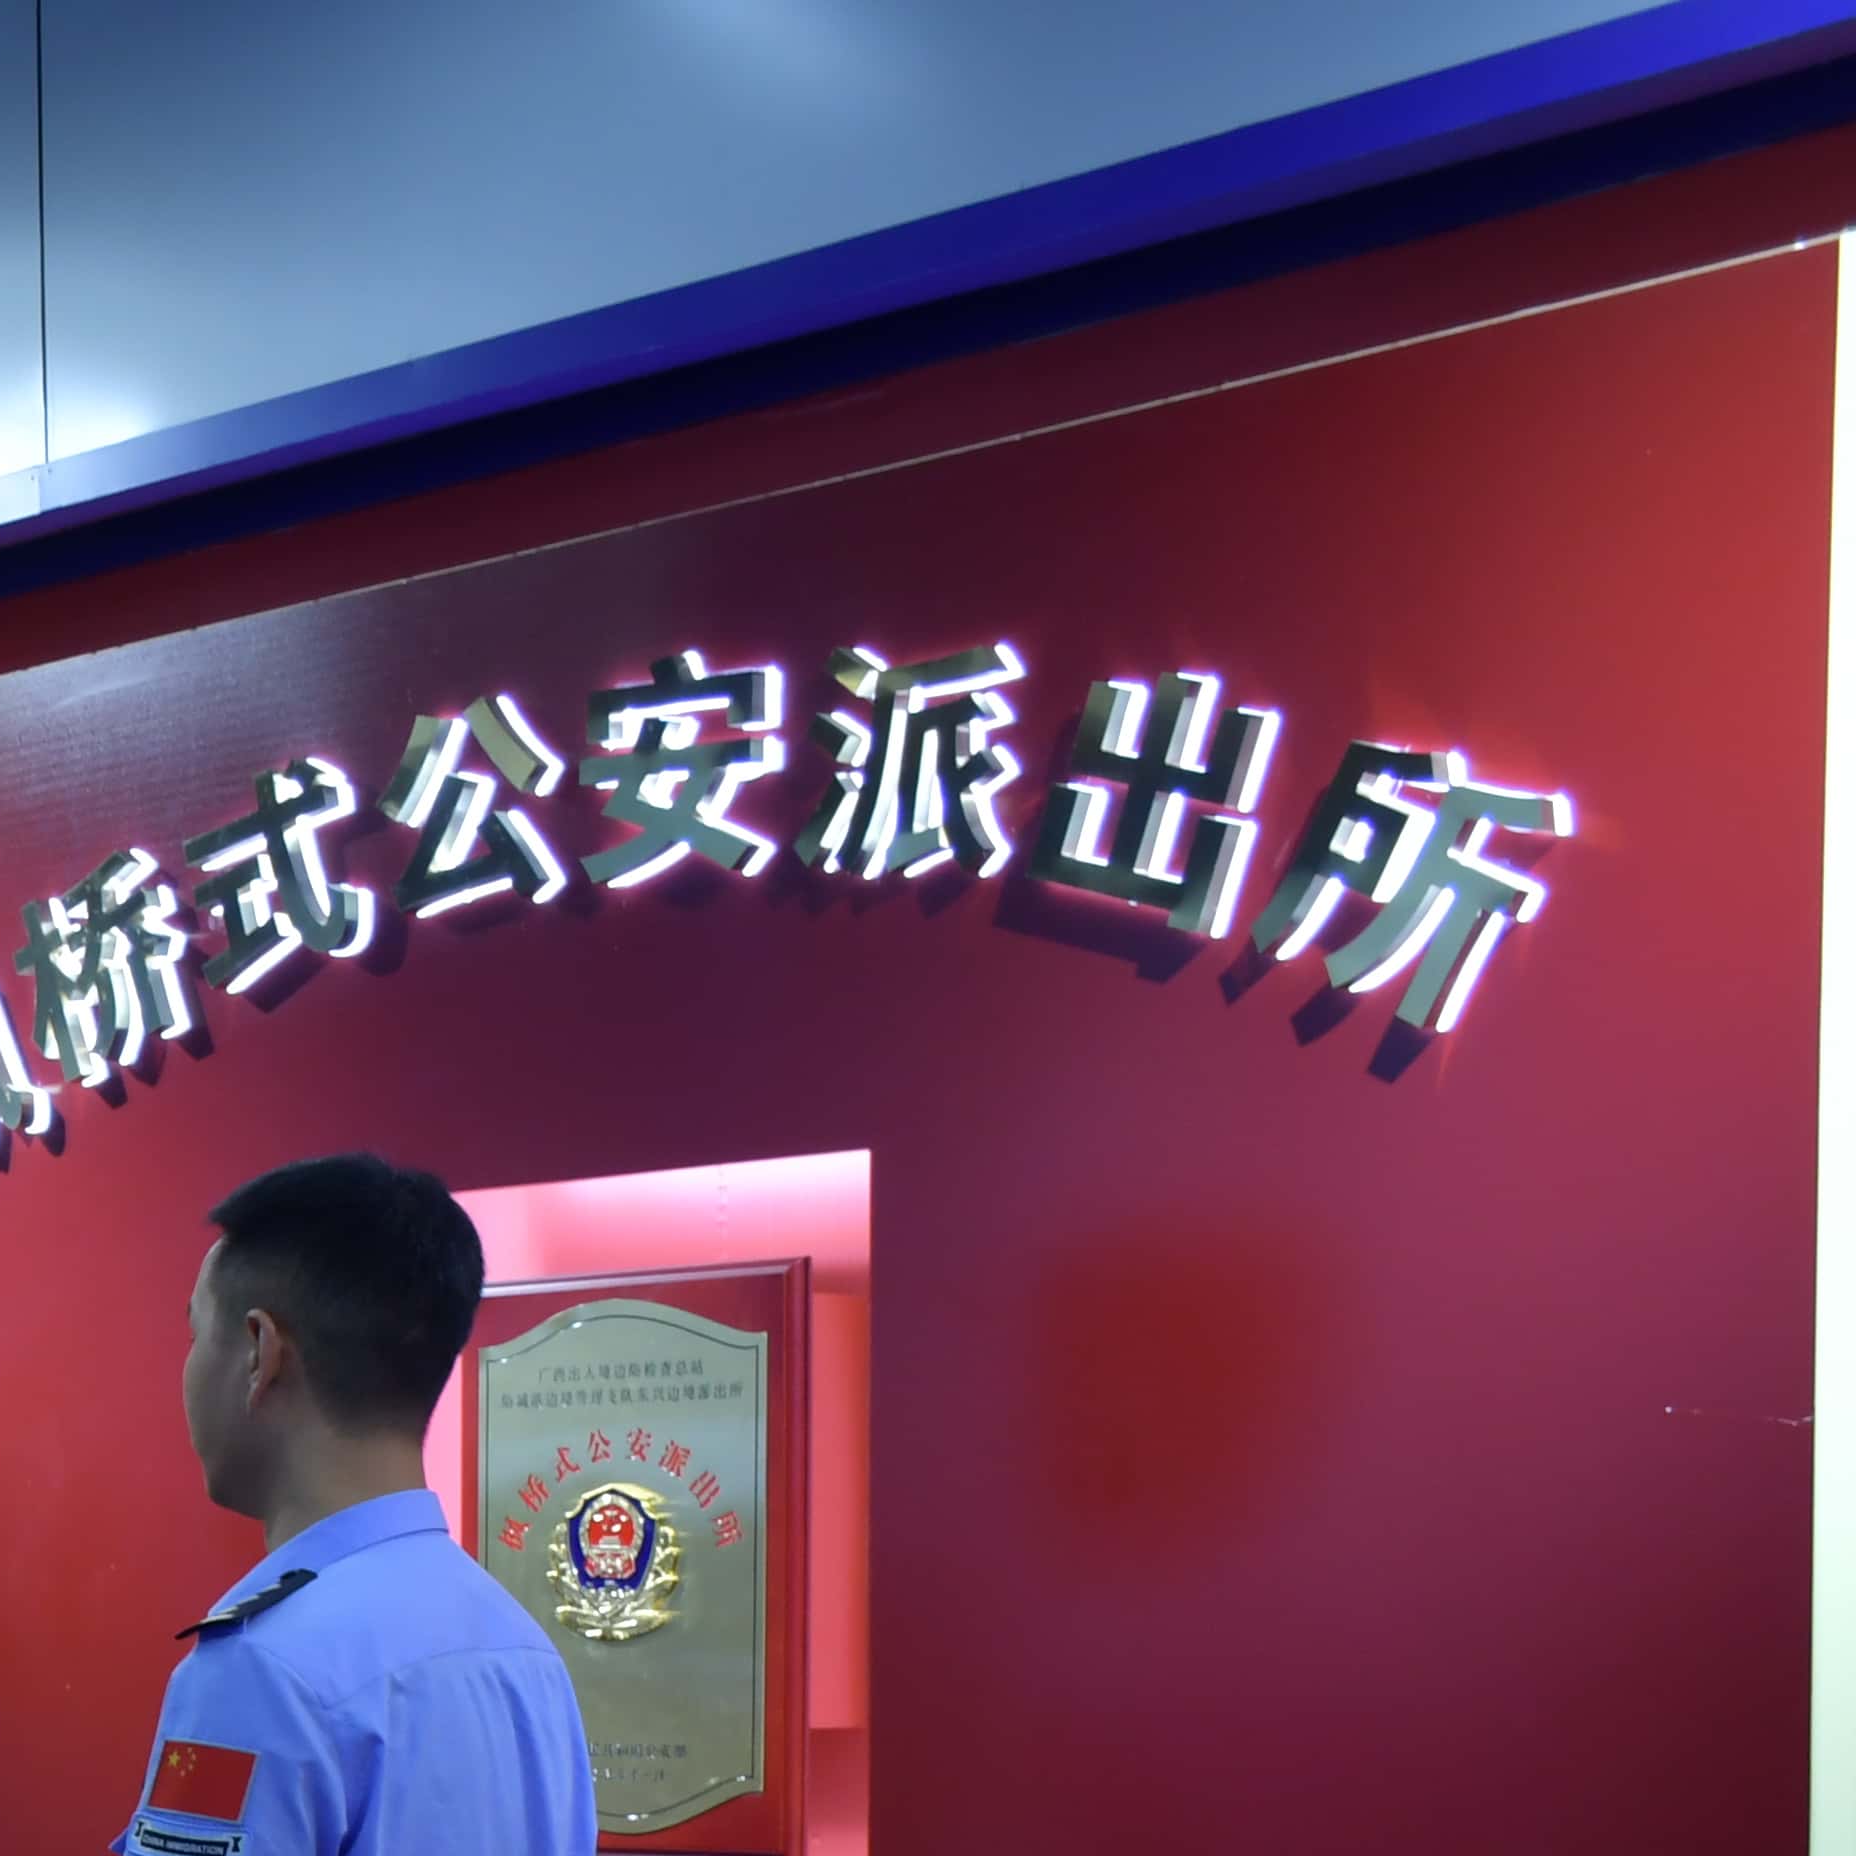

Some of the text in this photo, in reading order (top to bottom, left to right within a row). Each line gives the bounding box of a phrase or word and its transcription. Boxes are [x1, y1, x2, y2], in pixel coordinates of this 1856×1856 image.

[497, 1427, 744, 1552] 枫桥式公安派出所
